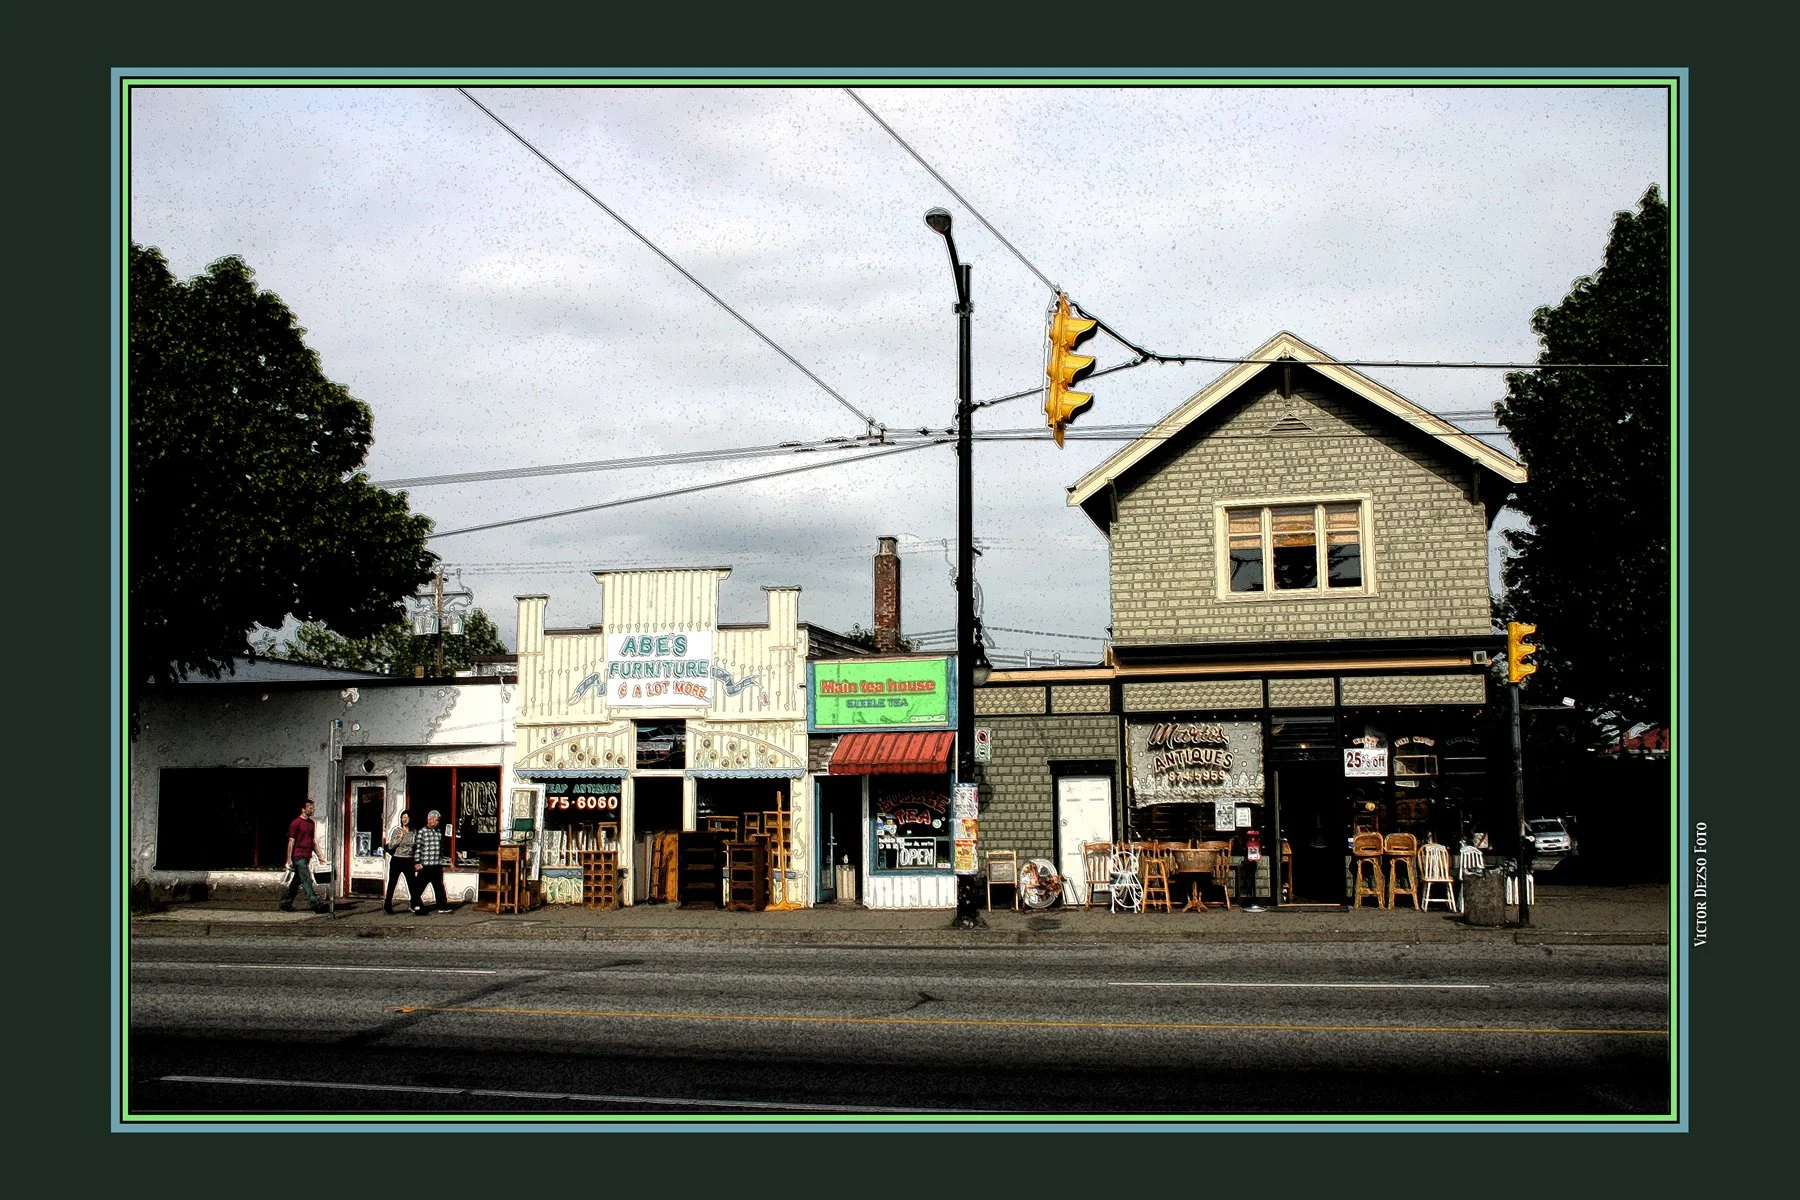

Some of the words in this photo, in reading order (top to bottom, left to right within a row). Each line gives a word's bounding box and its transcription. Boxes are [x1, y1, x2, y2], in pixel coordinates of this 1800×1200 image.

[619, 633, 688, 657] ABE'S
[608, 660, 709, 679] FURNITURE
[632, 684, 642, 698] A
[646, 681, 670, 697] LOT
[673, 681, 708, 699] MORE
[820, 680, 858, 693] Main
[860, 680, 884, 693] tea
[887, 678, 936, 692] house
[887, 698, 909, 707] TEA
[1154, 747, 1234, 772] ANTIQUES
[1346, 751, 1371, 768] 25%
[1373, 755, 1386, 768] off
[893, 809, 931, 825] TEA
[899, 849, 933, 865] OPEN
